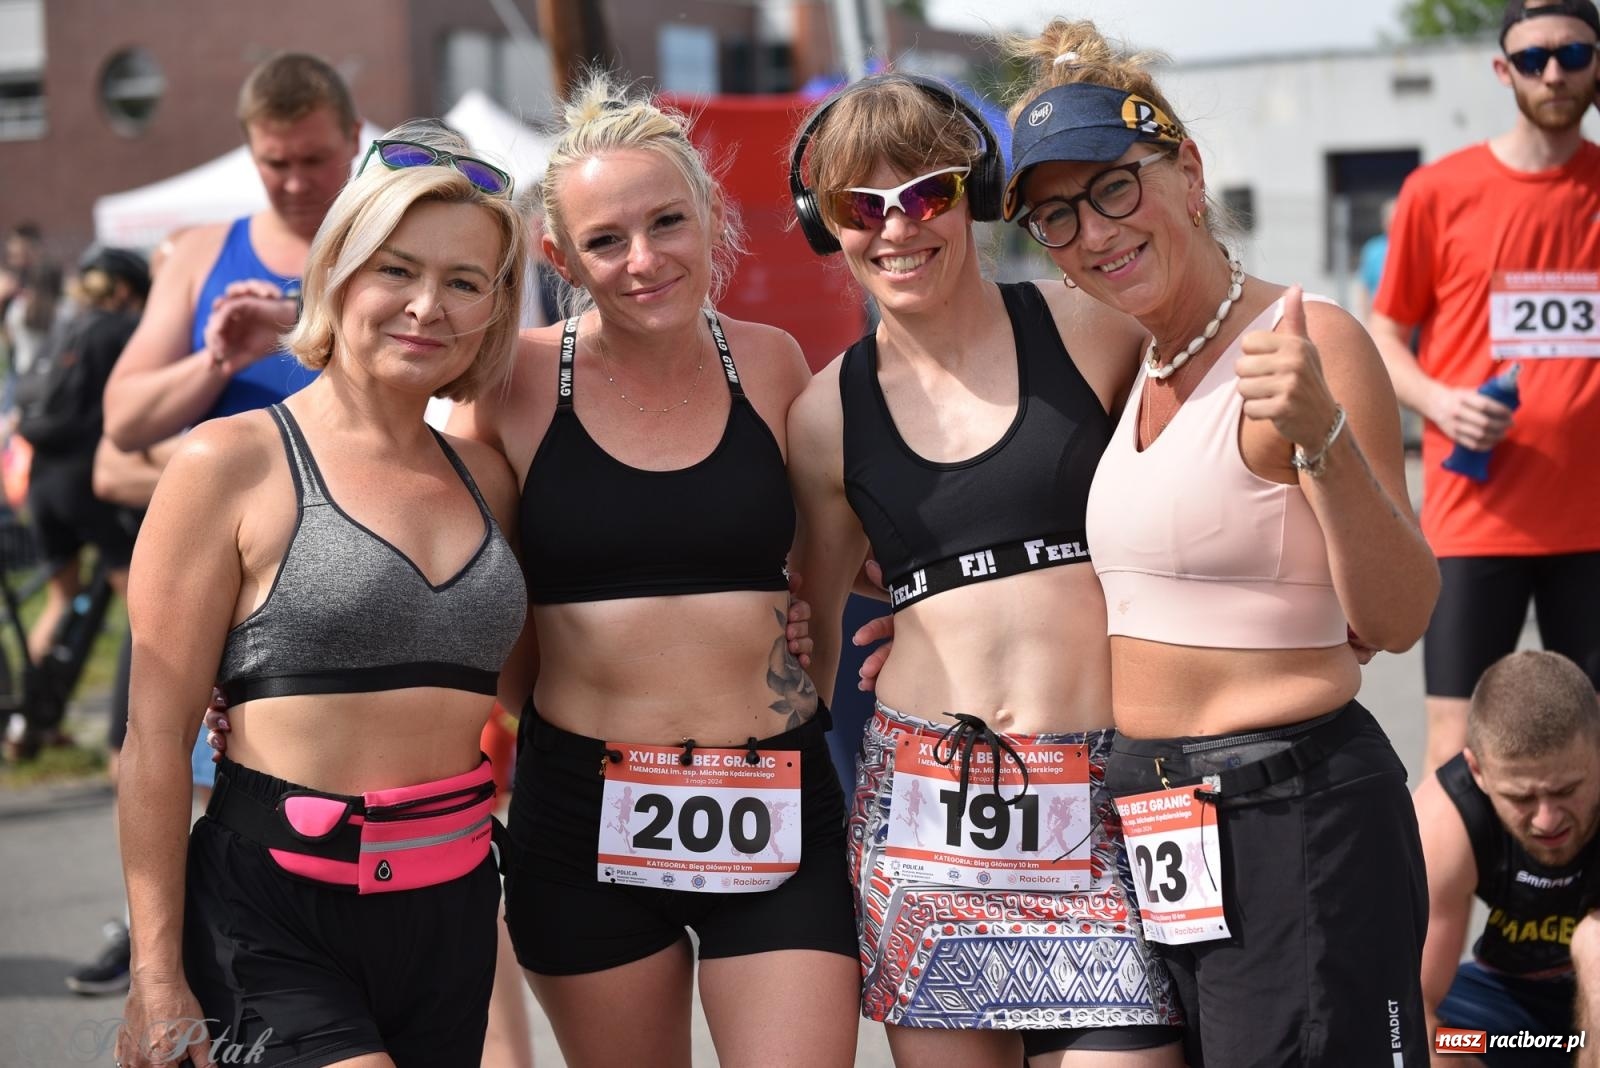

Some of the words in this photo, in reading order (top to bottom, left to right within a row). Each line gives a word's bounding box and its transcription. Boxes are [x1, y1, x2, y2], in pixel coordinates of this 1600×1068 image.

[1514, 299, 1595, 332] 203
[560, 370, 572, 397] GYM
[958, 549, 998, 578] FJ!
[629, 750, 655, 765] XVI
[656, 752, 682, 766] BIE
[692, 754, 721, 767] BEZ
[1130, 801, 1149, 815] BEZ
[1149, 794, 1192, 812] GRANIC
[632, 793, 772, 855] 200
[939, 788, 1039, 852] 191
[616, 869, 638, 877] POLICJA
[646, 860, 688, 870] KATEGORIA:
[740, 864, 753, 872] km
[733, 877, 771, 886] Racibórz
[1019, 875, 1061, 884] Racibórz
[1387, 999, 1402, 1049] EVADICT
